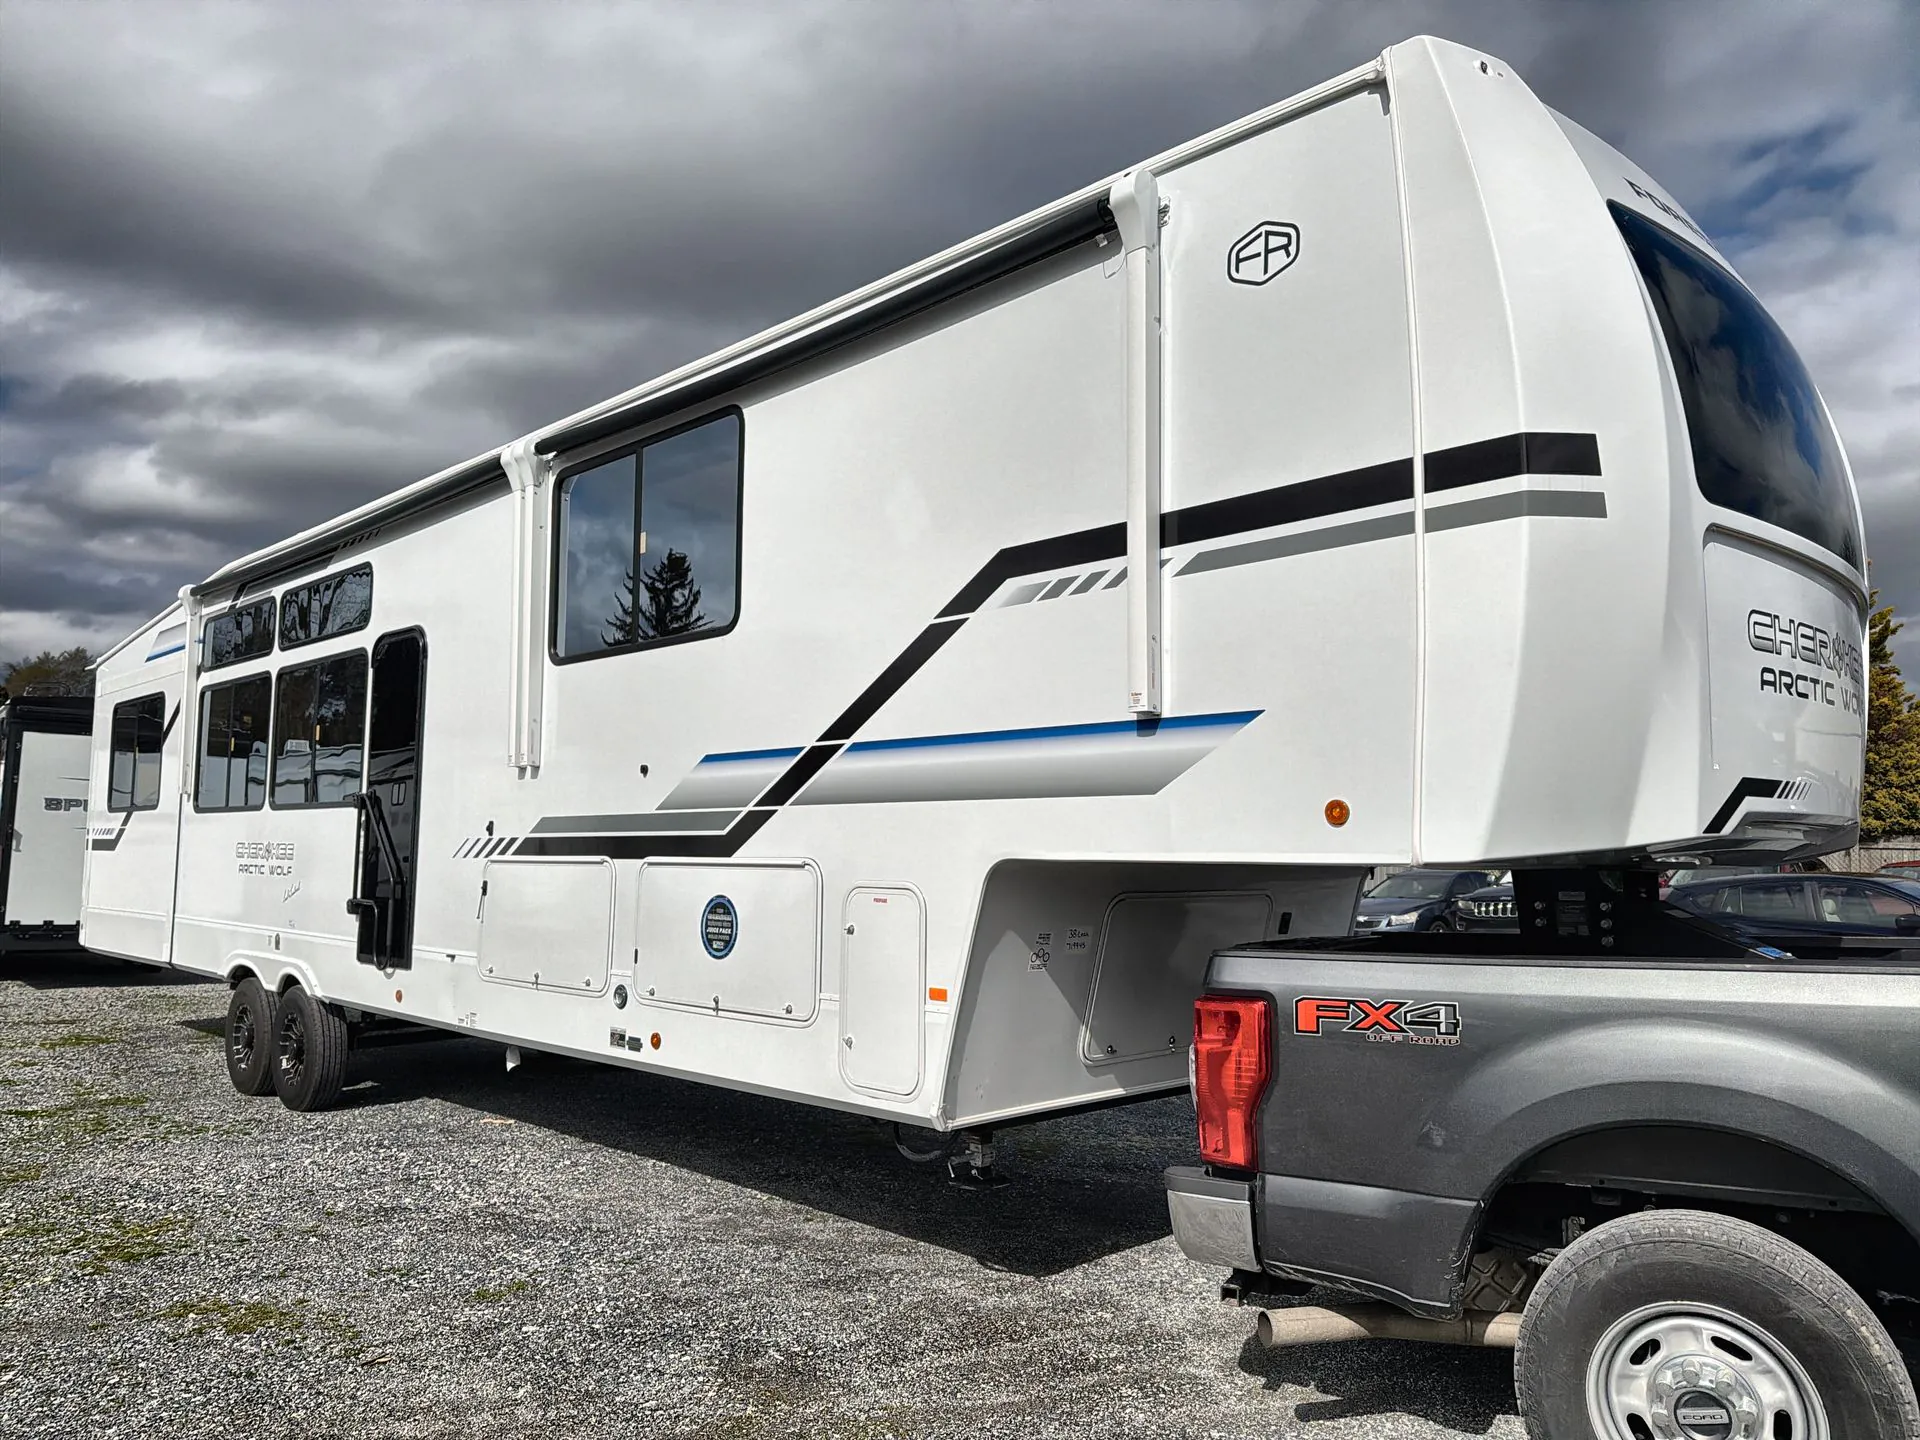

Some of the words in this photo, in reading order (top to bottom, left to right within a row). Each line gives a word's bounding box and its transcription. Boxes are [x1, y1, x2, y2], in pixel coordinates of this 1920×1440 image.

[1760, 666, 1835, 706] ARCTIC
[1841, 686, 1865, 719] WO
[236, 842, 295, 861] CHEROKEE
[238, 863, 265, 875] ARCTIC
[269, 864, 292, 876] WOLF
[1294, 996, 1462, 1037] FX4
[1366, 1033, 1403, 1043] OFF
[1409, 1036, 1461, 1046] ROAD
